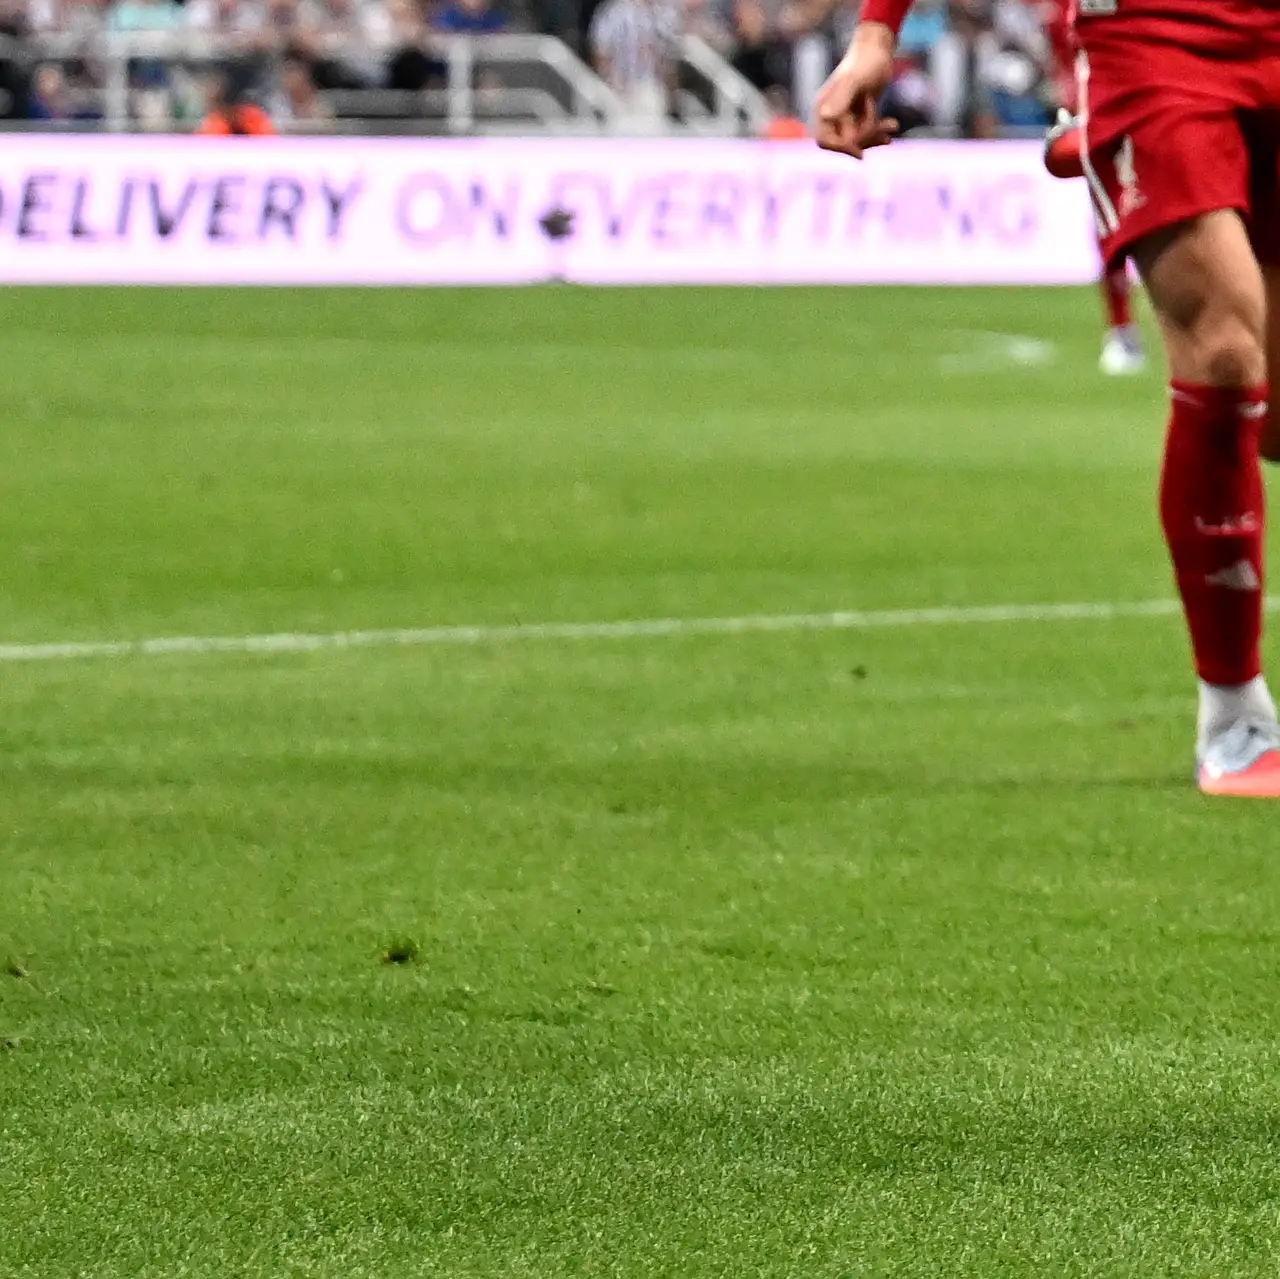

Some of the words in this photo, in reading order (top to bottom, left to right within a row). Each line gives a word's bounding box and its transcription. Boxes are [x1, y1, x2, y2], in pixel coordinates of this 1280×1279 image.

[0, 172, 362, 243] ELIVERY
[393, 171, 516, 245] ON
[554, 171, 1038, 245] EVERYTHING
